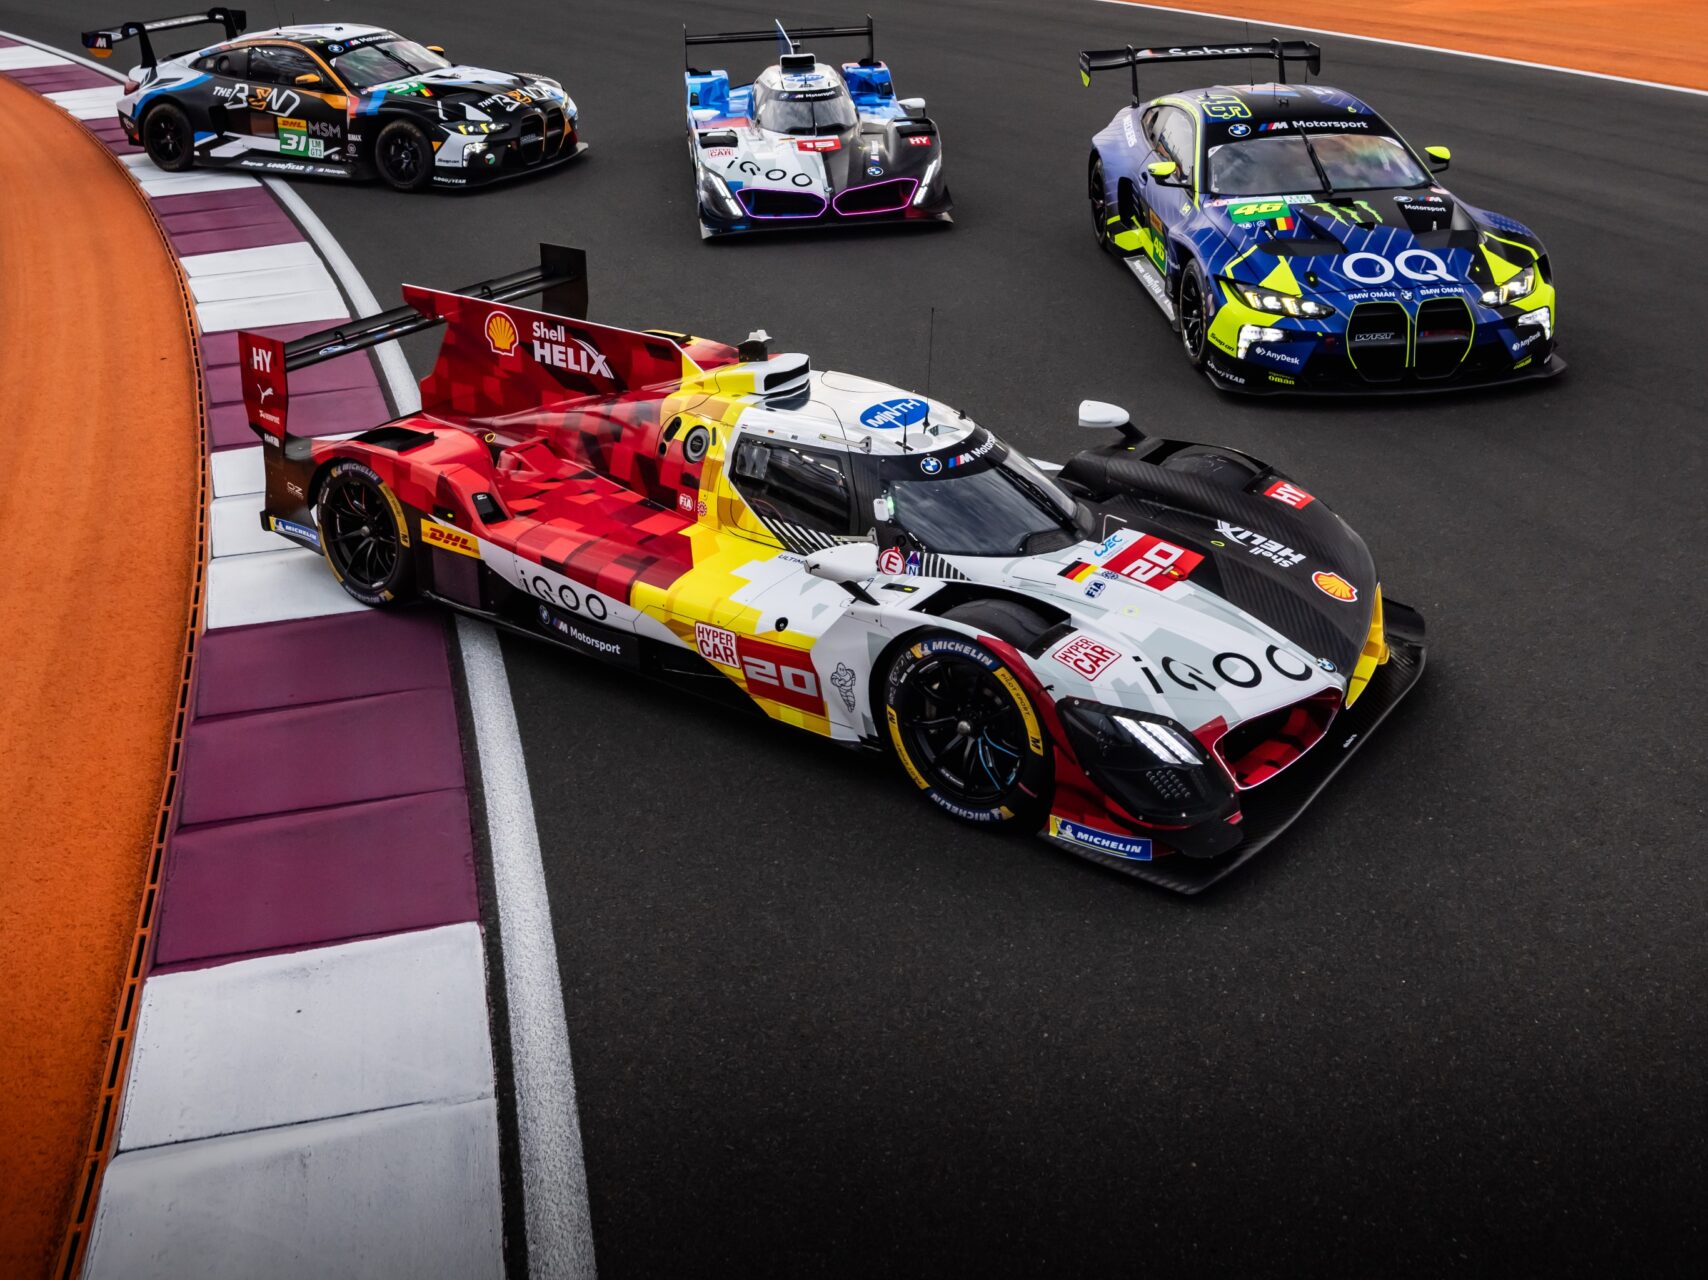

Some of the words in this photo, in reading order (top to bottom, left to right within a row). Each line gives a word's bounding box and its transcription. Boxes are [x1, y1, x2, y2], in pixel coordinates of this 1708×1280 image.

[213, 86, 231, 98] THE
[282, 119, 305, 128] DHL
[308, 121, 341, 138] MSM
[1292, 120, 1368, 129] Motorsport
[281, 133, 307, 151] 31
[909, 137, 928, 145] HY
[310, 148, 322, 158] GT3
[1233, 203, 1284, 215] 46
[1404, 204, 1446, 212] Motorsport
[1348, 292, 1369, 300] BMW
[532, 321, 566, 343] Shell
[1355, 332, 1395, 341] WRT
[1520, 331, 1541, 347] AnyDesk
[252, 347, 272, 373] HY
[532, 338, 615, 380] HELIX
[1266, 350, 1300, 365] AnyDesk
[971, 429, 996, 458] Motors
[342, 462, 379, 481] MICHELIN
[286, 481, 303, 495] OZ
[1270, 483, 1306, 506] HY
[285, 524, 317, 540] MICHELIN
[401, 533, 409, 543] M
[429, 527, 472, 552] DHL
[1214, 519, 1307, 564] HELIX
[1094, 535, 1123, 558] WEC
[885, 554, 900, 569] E
[1121, 541, 1185, 582] 20
[1249, 547, 1294, 568] Shell
[908, 565, 917, 576] N
[1086, 581, 1104, 598] FIA
[570, 626, 621, 655] Motorsport
[697, 625, 733, 647] HYPER
[700, 640, 737, 665] CAR
[932, 640, 993, 666] MICHELIN
[1058, 637, 1091, 665] HYPER
[1072, 644, 1116, 680] CAR
[742, 655, 819, 698] 20
[1000, 673, 1017, 693] PILOT
[1015, 692, 1030, 719] SPORT
[1031, 736, 1041, 750] M
[930, 792, 992, 821] MICHELIN
[1076, 830, 1143, 854] MICHELIN
